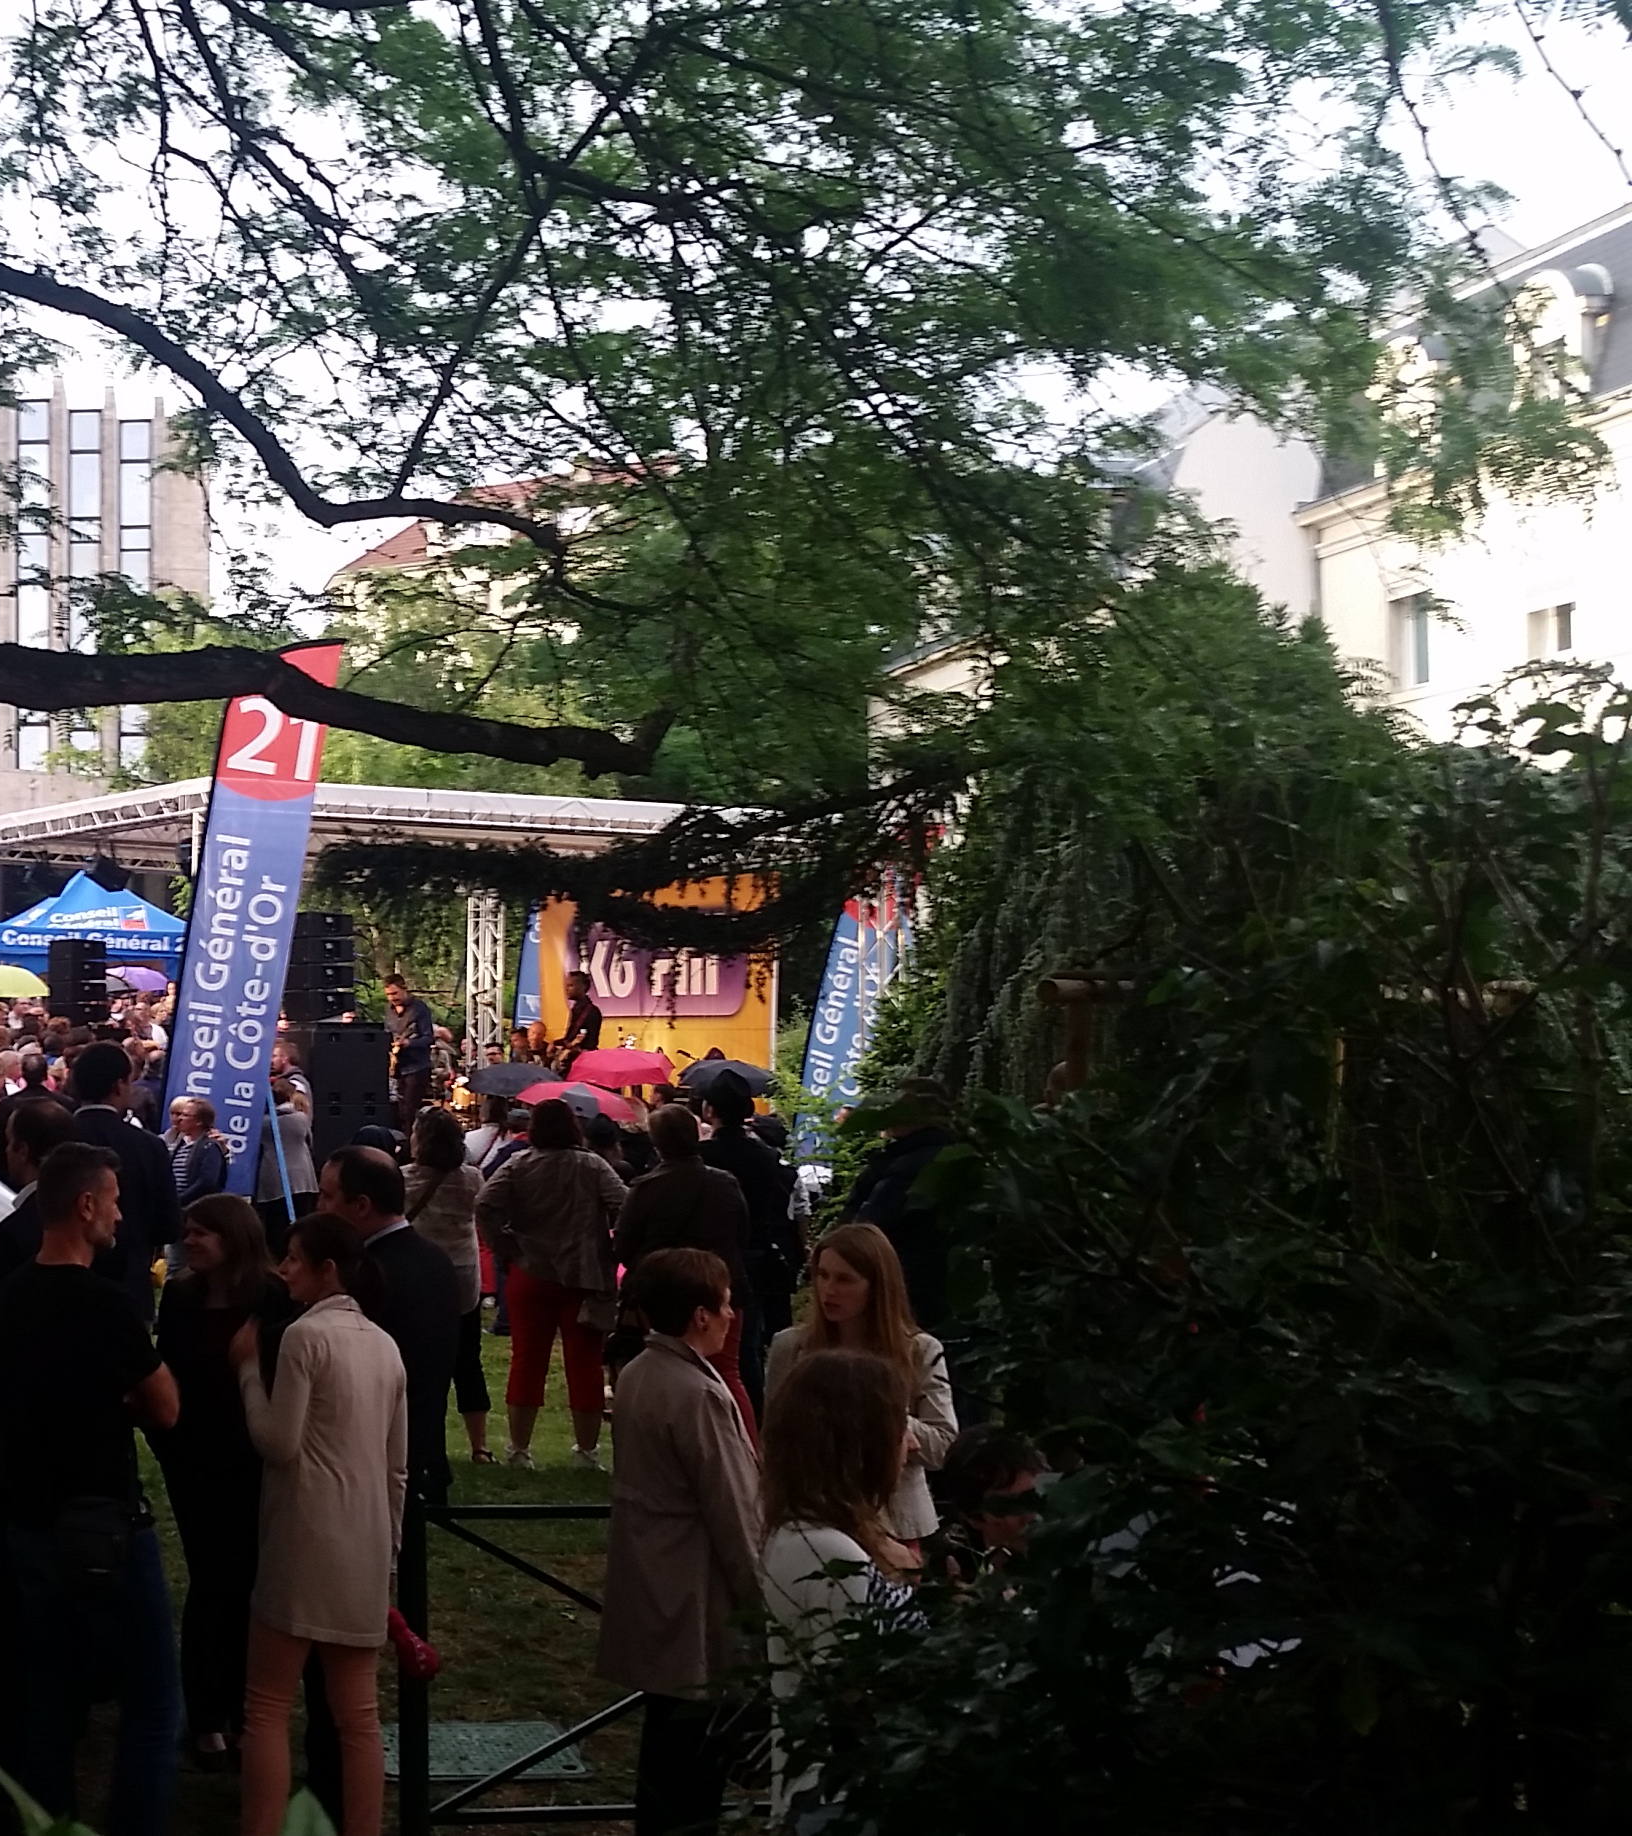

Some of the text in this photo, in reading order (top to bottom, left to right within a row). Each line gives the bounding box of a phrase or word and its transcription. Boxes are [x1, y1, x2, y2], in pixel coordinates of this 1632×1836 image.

[226, 694, 319, 781] 21
[49, 906, 118, 923] Conseil
[186, 834, 252, 1096] nseil Général
[815, 935, 860, 1045] Général
[223, 875, 288, 1155] de la Côte-d'Or
[810, 1049, 834, 1099] seil
